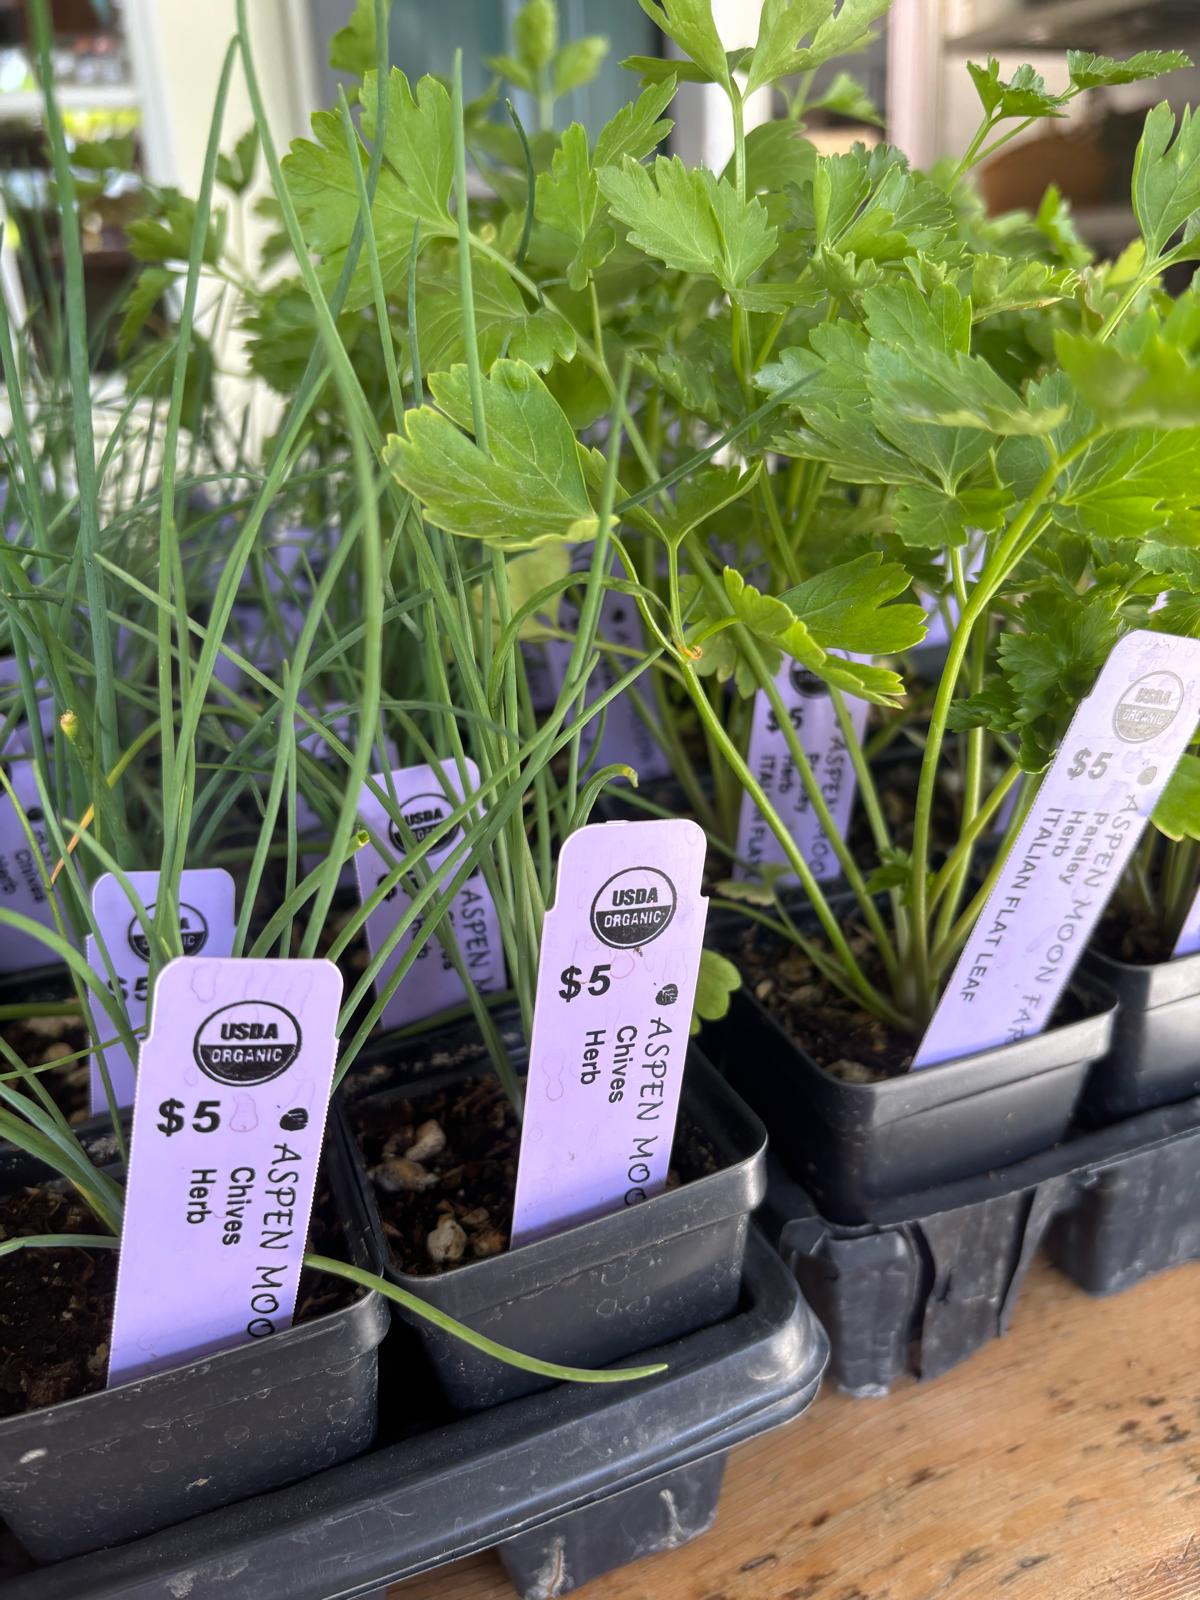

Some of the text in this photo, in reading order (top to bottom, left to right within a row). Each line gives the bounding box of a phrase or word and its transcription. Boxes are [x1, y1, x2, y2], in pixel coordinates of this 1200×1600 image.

[1067, 747, 1113, 780] $5
[404, 807, 445, 827] USDA
[1051, 810, 1087, 858] Herb
[1082, 793, 1140, 889] ASPEN
[1058, 811, 1108, 886] Parsley
[603, 909, 663, 928] ORGANIC
[611, 886, 659, 907] USDA
[960, 807, 1064, 1003] ITALIAN FLAT LEAF
[461, 888, 491, 968] ASPEN
[1034, 899, 1092, 983] MOON
[558, 964, 612, 1003] $5
[209, 1046, 284, 1064] ORGANIC
[220, 1021, 280, 1041] USDA
[580, 1029, 606, 1086] Herb
[608, 1025, 638, 1104] Chives
[637, 1016, 673, 1122] ASPEN
[157, 1097, 222, 1137] $5
[186, 1168, 217, 1226] Herb
[222, 1167, 256, 1247] Chives
[259, 1142, 302, 1251] ASPEN
